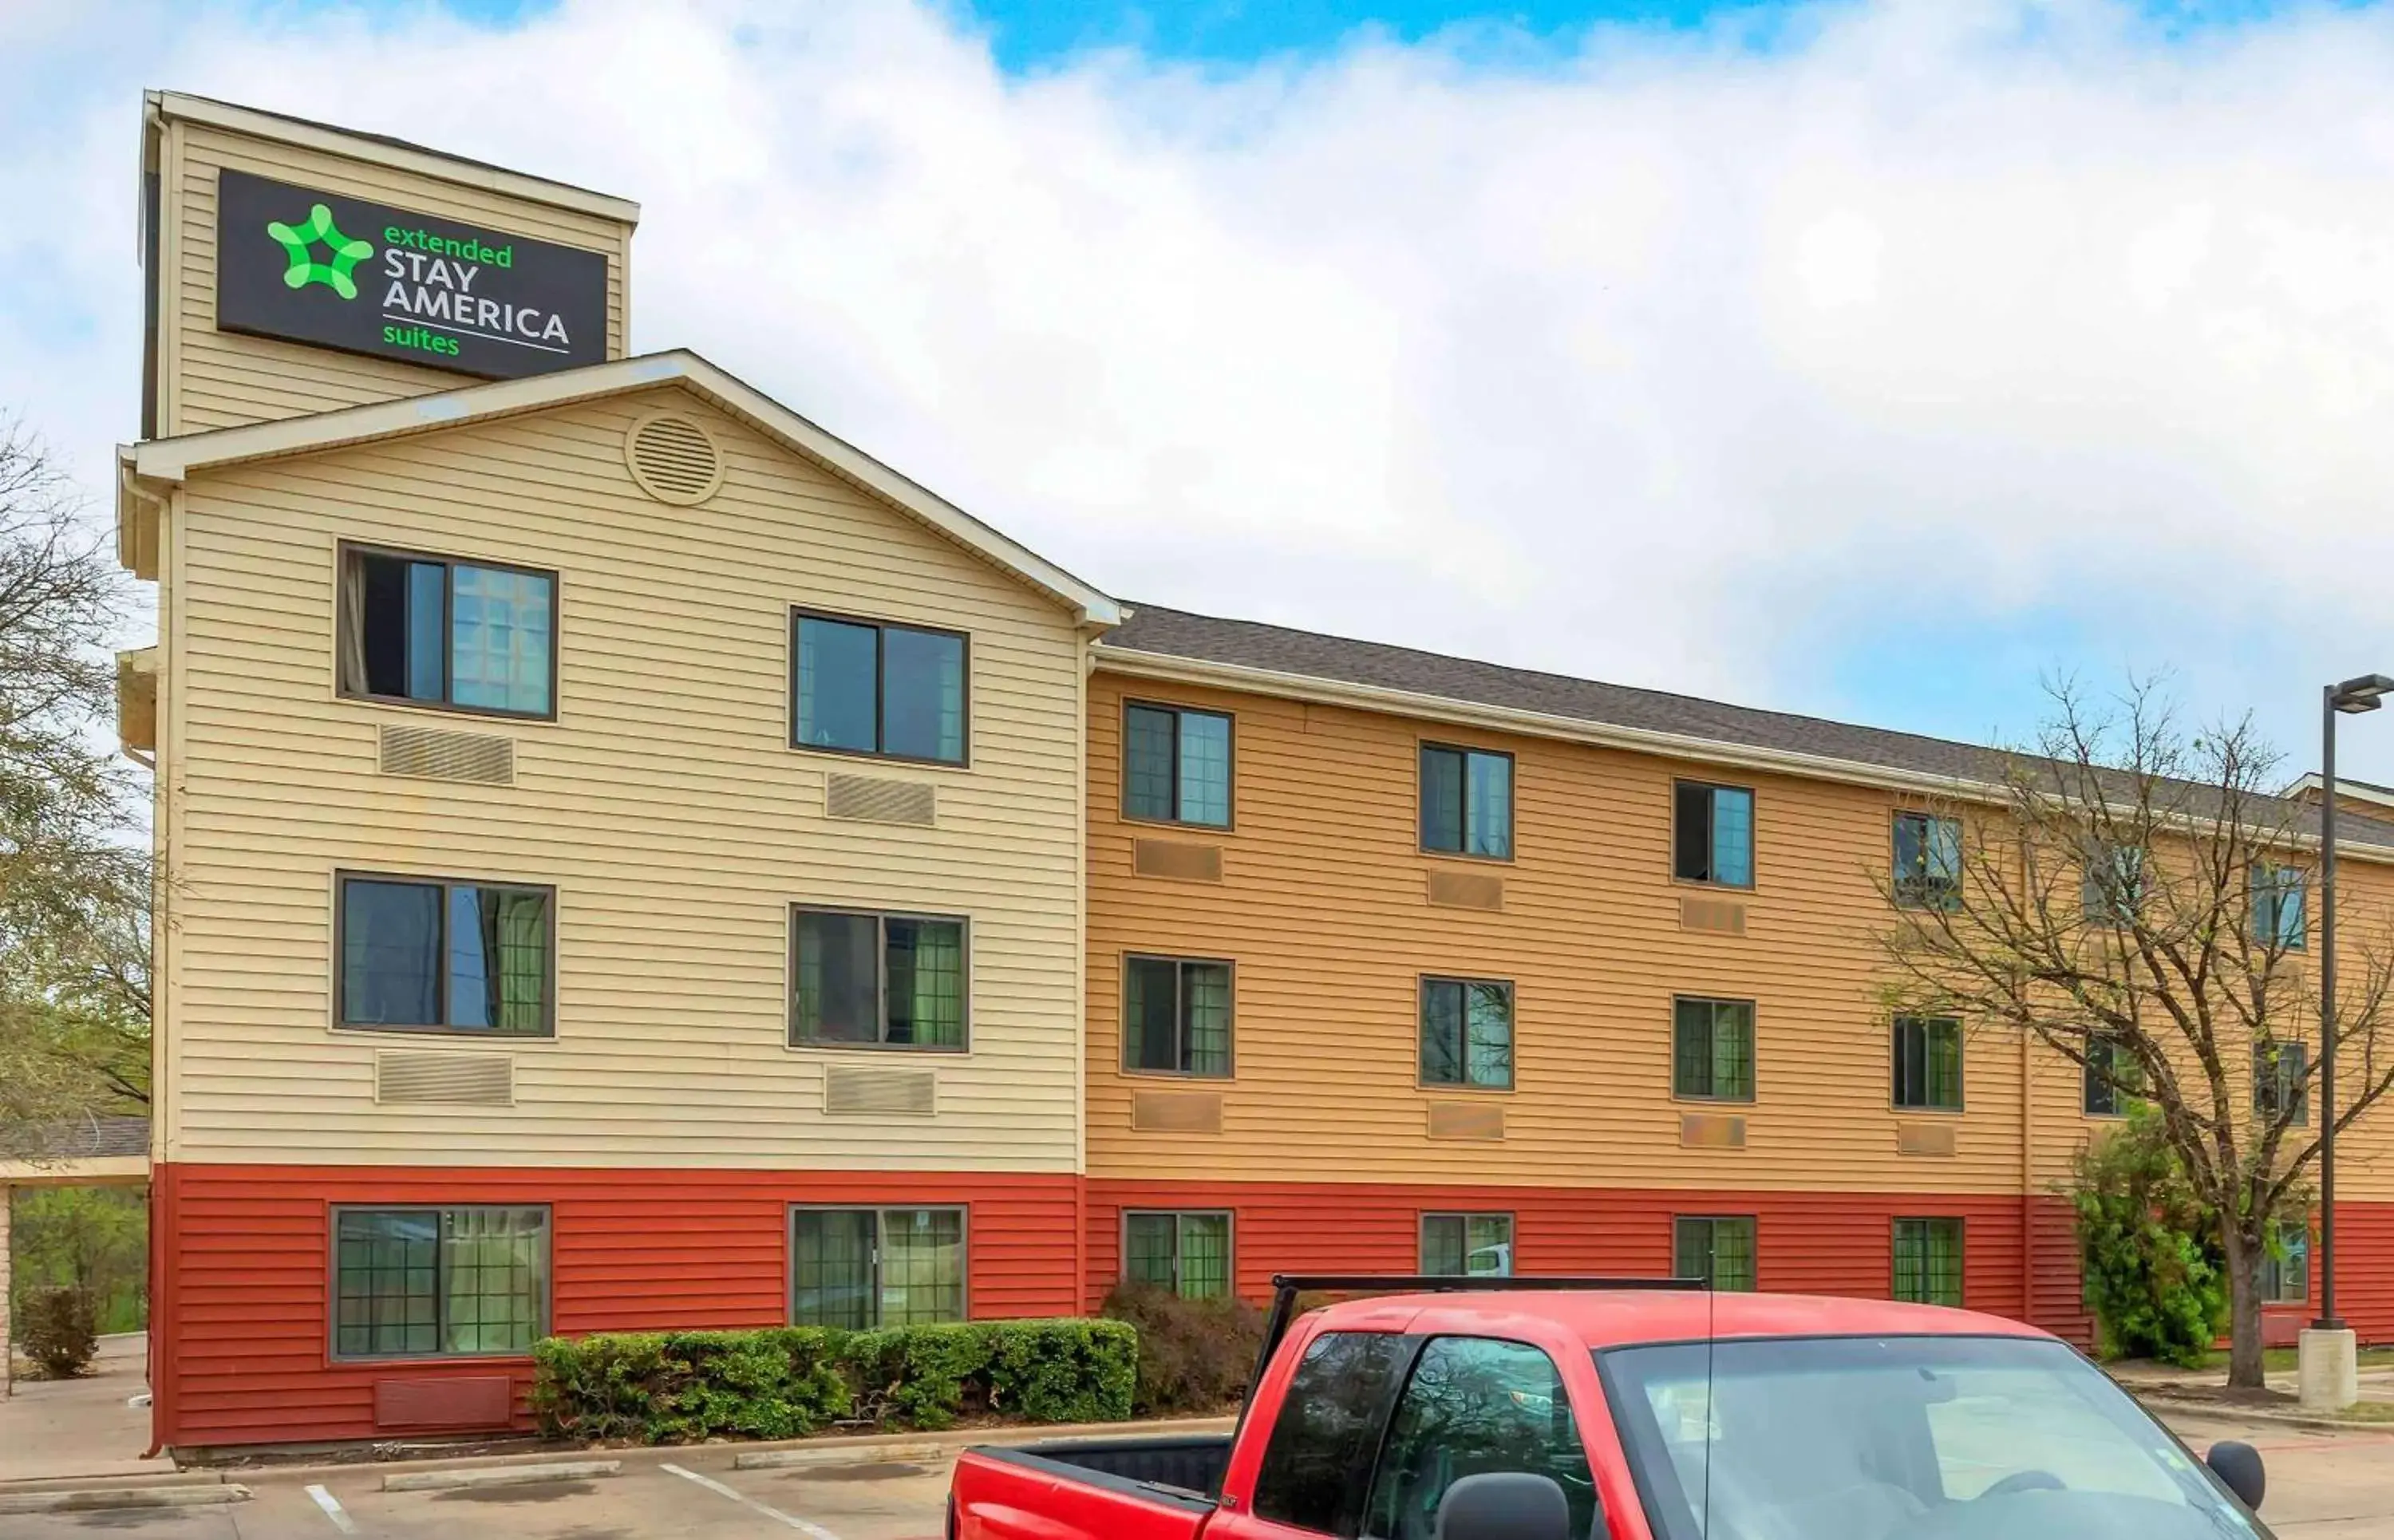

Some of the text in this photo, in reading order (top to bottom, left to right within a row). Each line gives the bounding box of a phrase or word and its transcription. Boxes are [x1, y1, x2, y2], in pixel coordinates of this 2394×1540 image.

[384, 226, 512, 268] extended
[384, 248, 479, 292] STAY
[382, 280, 570, 344] AMERICA
[383, 326, 460, 356] suites
